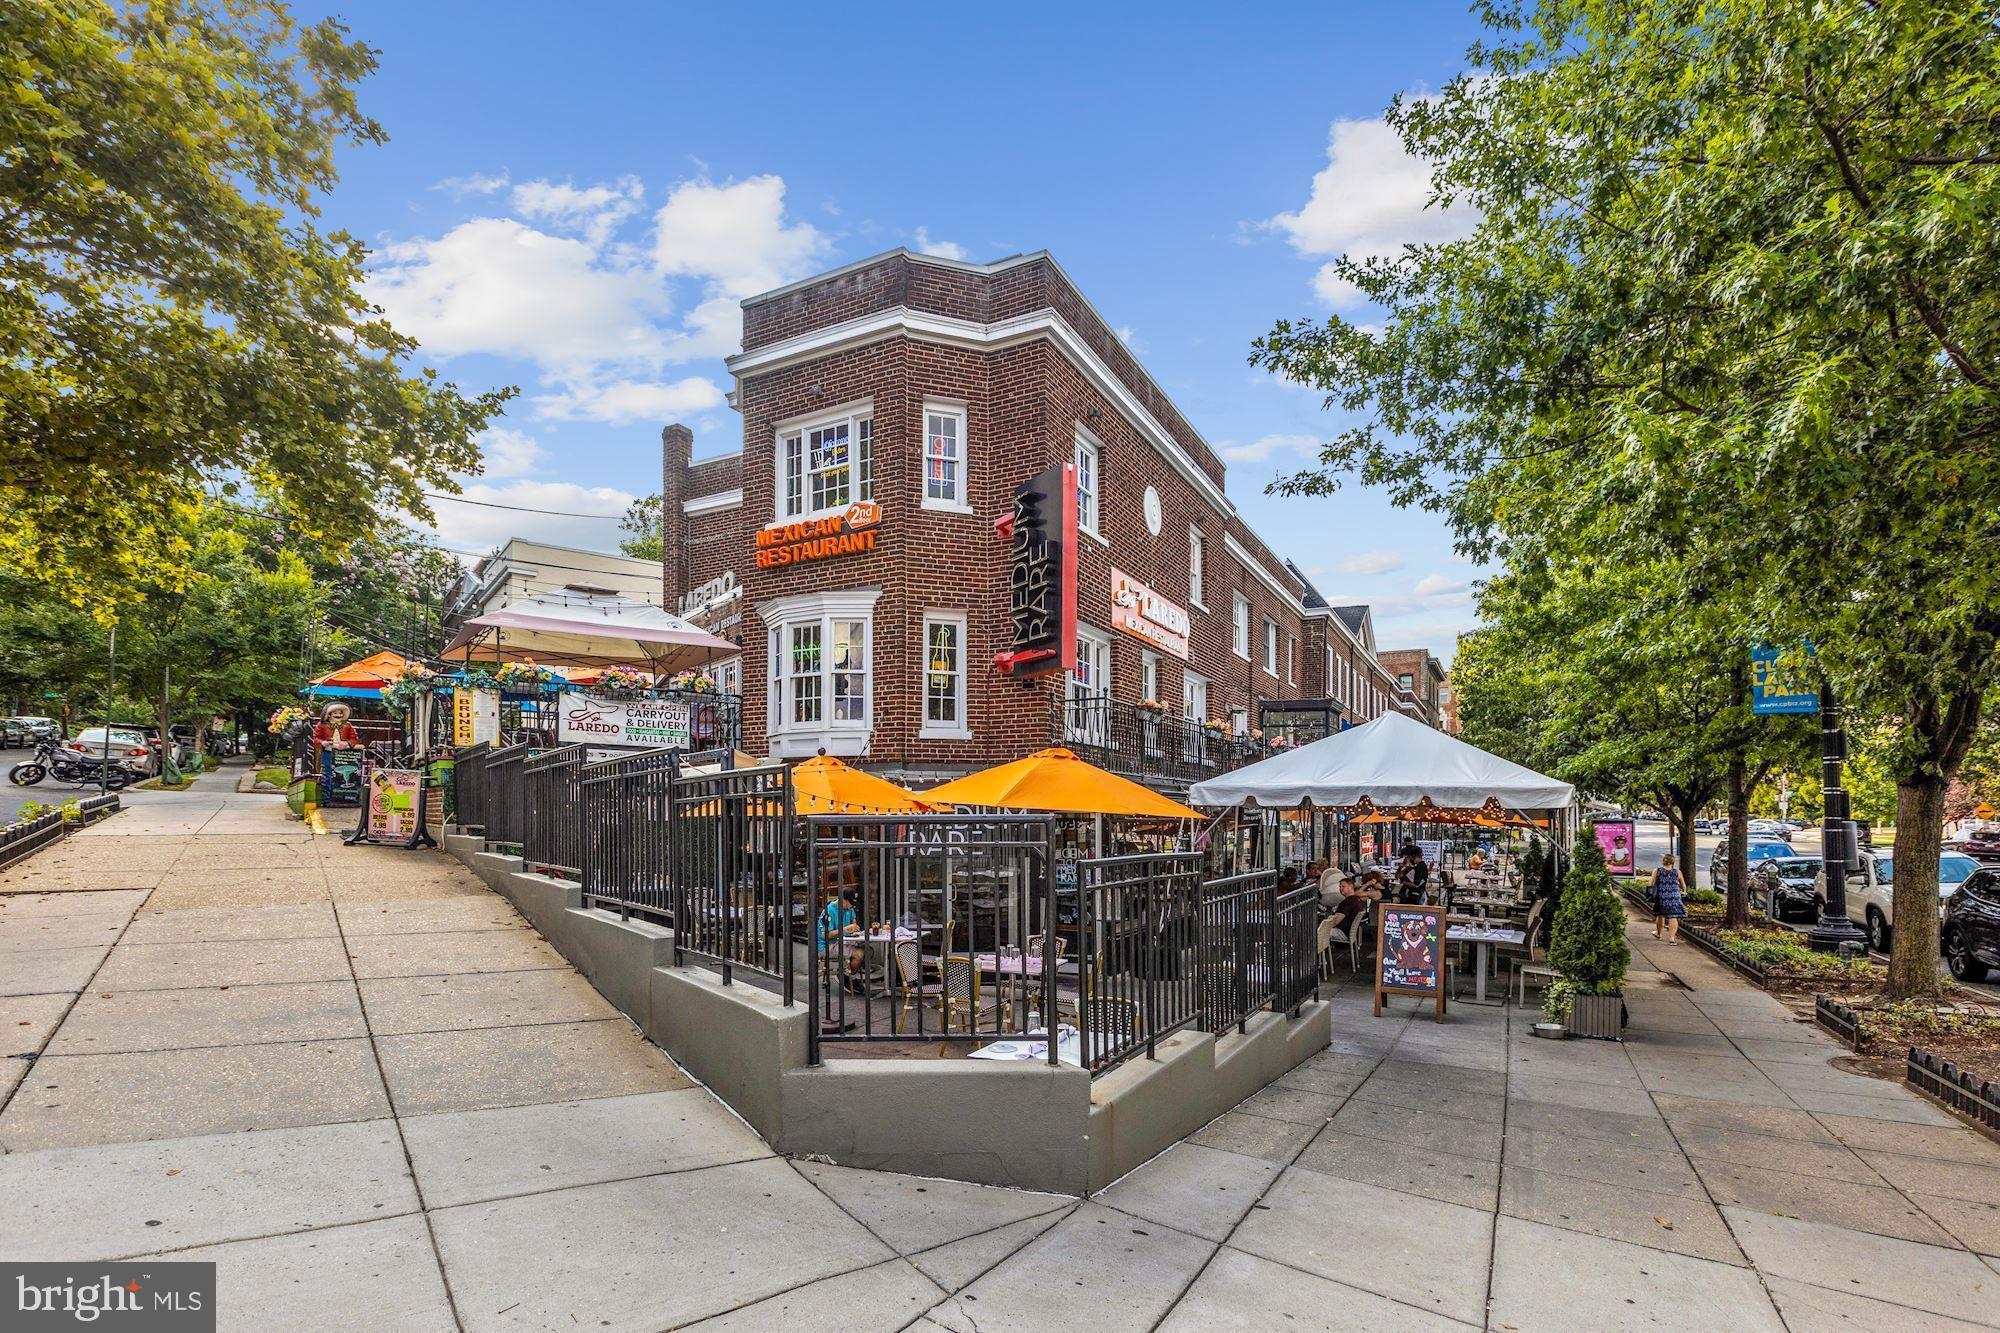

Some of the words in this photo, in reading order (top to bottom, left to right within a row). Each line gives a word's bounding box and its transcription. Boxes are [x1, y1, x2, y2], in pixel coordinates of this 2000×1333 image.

[850, 505, 872, 524] 2nd
[756, 515, 843, 548] MEXICAN
[756, 529, 878, 568] RESTAURANT
[1011, 490, 1030, 646] MEDIUM
[1029, 540, 1050, 641] RARE
[1139, 591, 1190, 639] LAREDO
[1125, 614, 1151, 638] MEXICAN
[1152, 627, 1184, 654] RESTAURANT
[568, 721, 620, 734] LAREDO
[626, 709, 687, 721] CARRYOUT
[626, 719, 634, 727] &
[637, 719, 687, 730] DELIVERY
[626, 735, 685, 744] AVAILABLE
